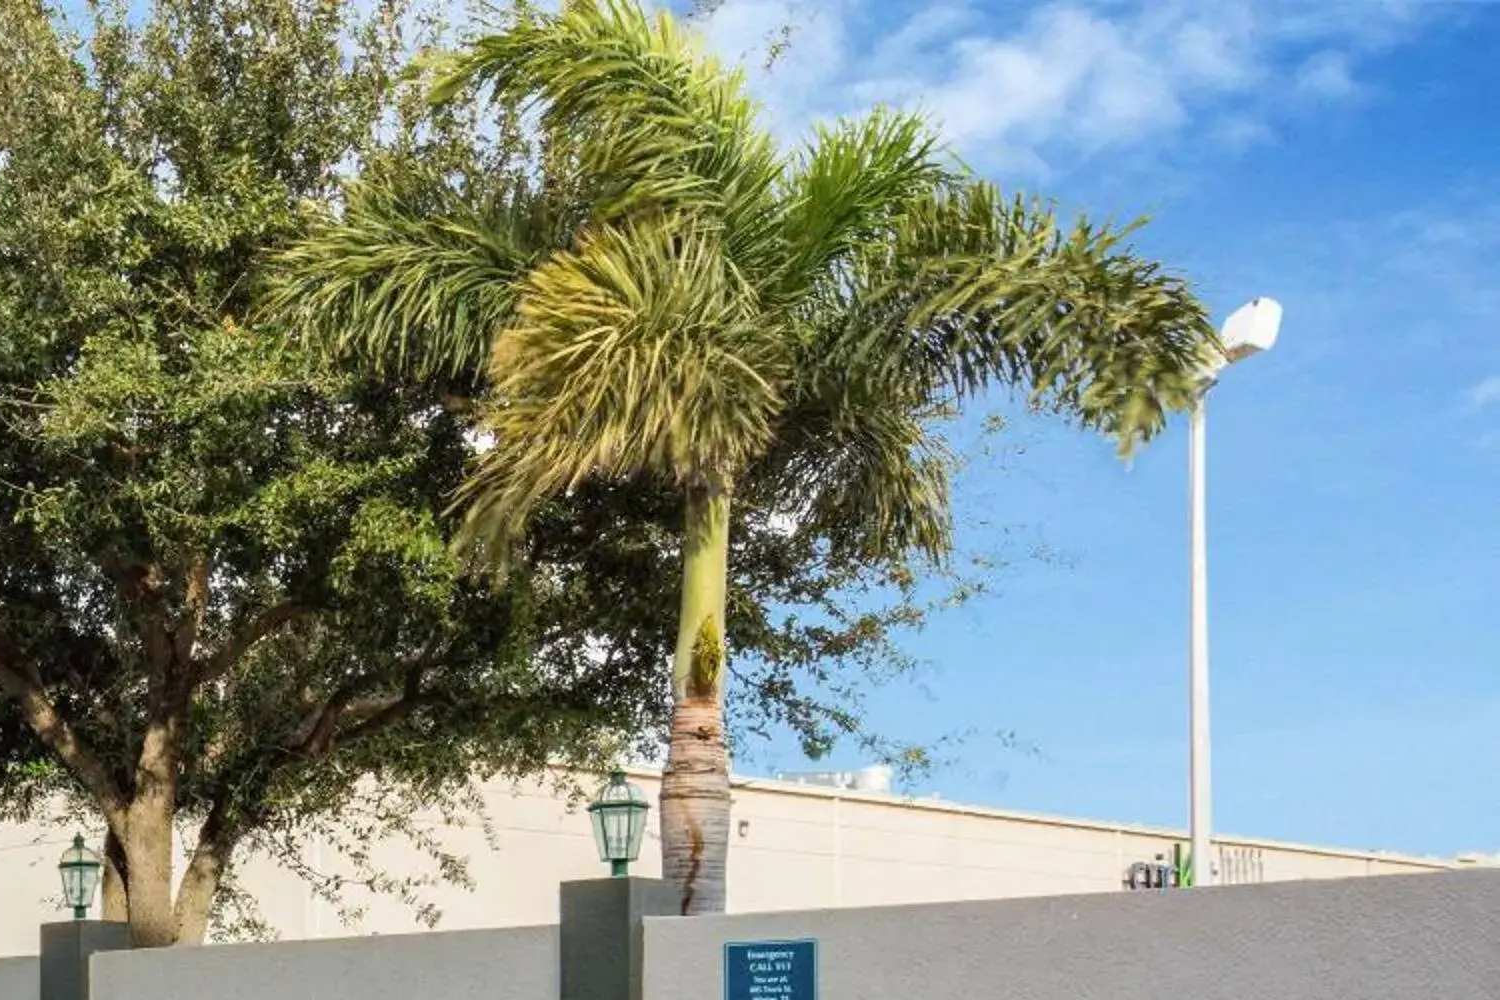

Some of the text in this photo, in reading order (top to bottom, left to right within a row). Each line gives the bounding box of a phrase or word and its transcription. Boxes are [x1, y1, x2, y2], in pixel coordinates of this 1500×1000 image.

[747, 951, 794, 961] Emergency
[749, 962, 791, 972] CALL 911
